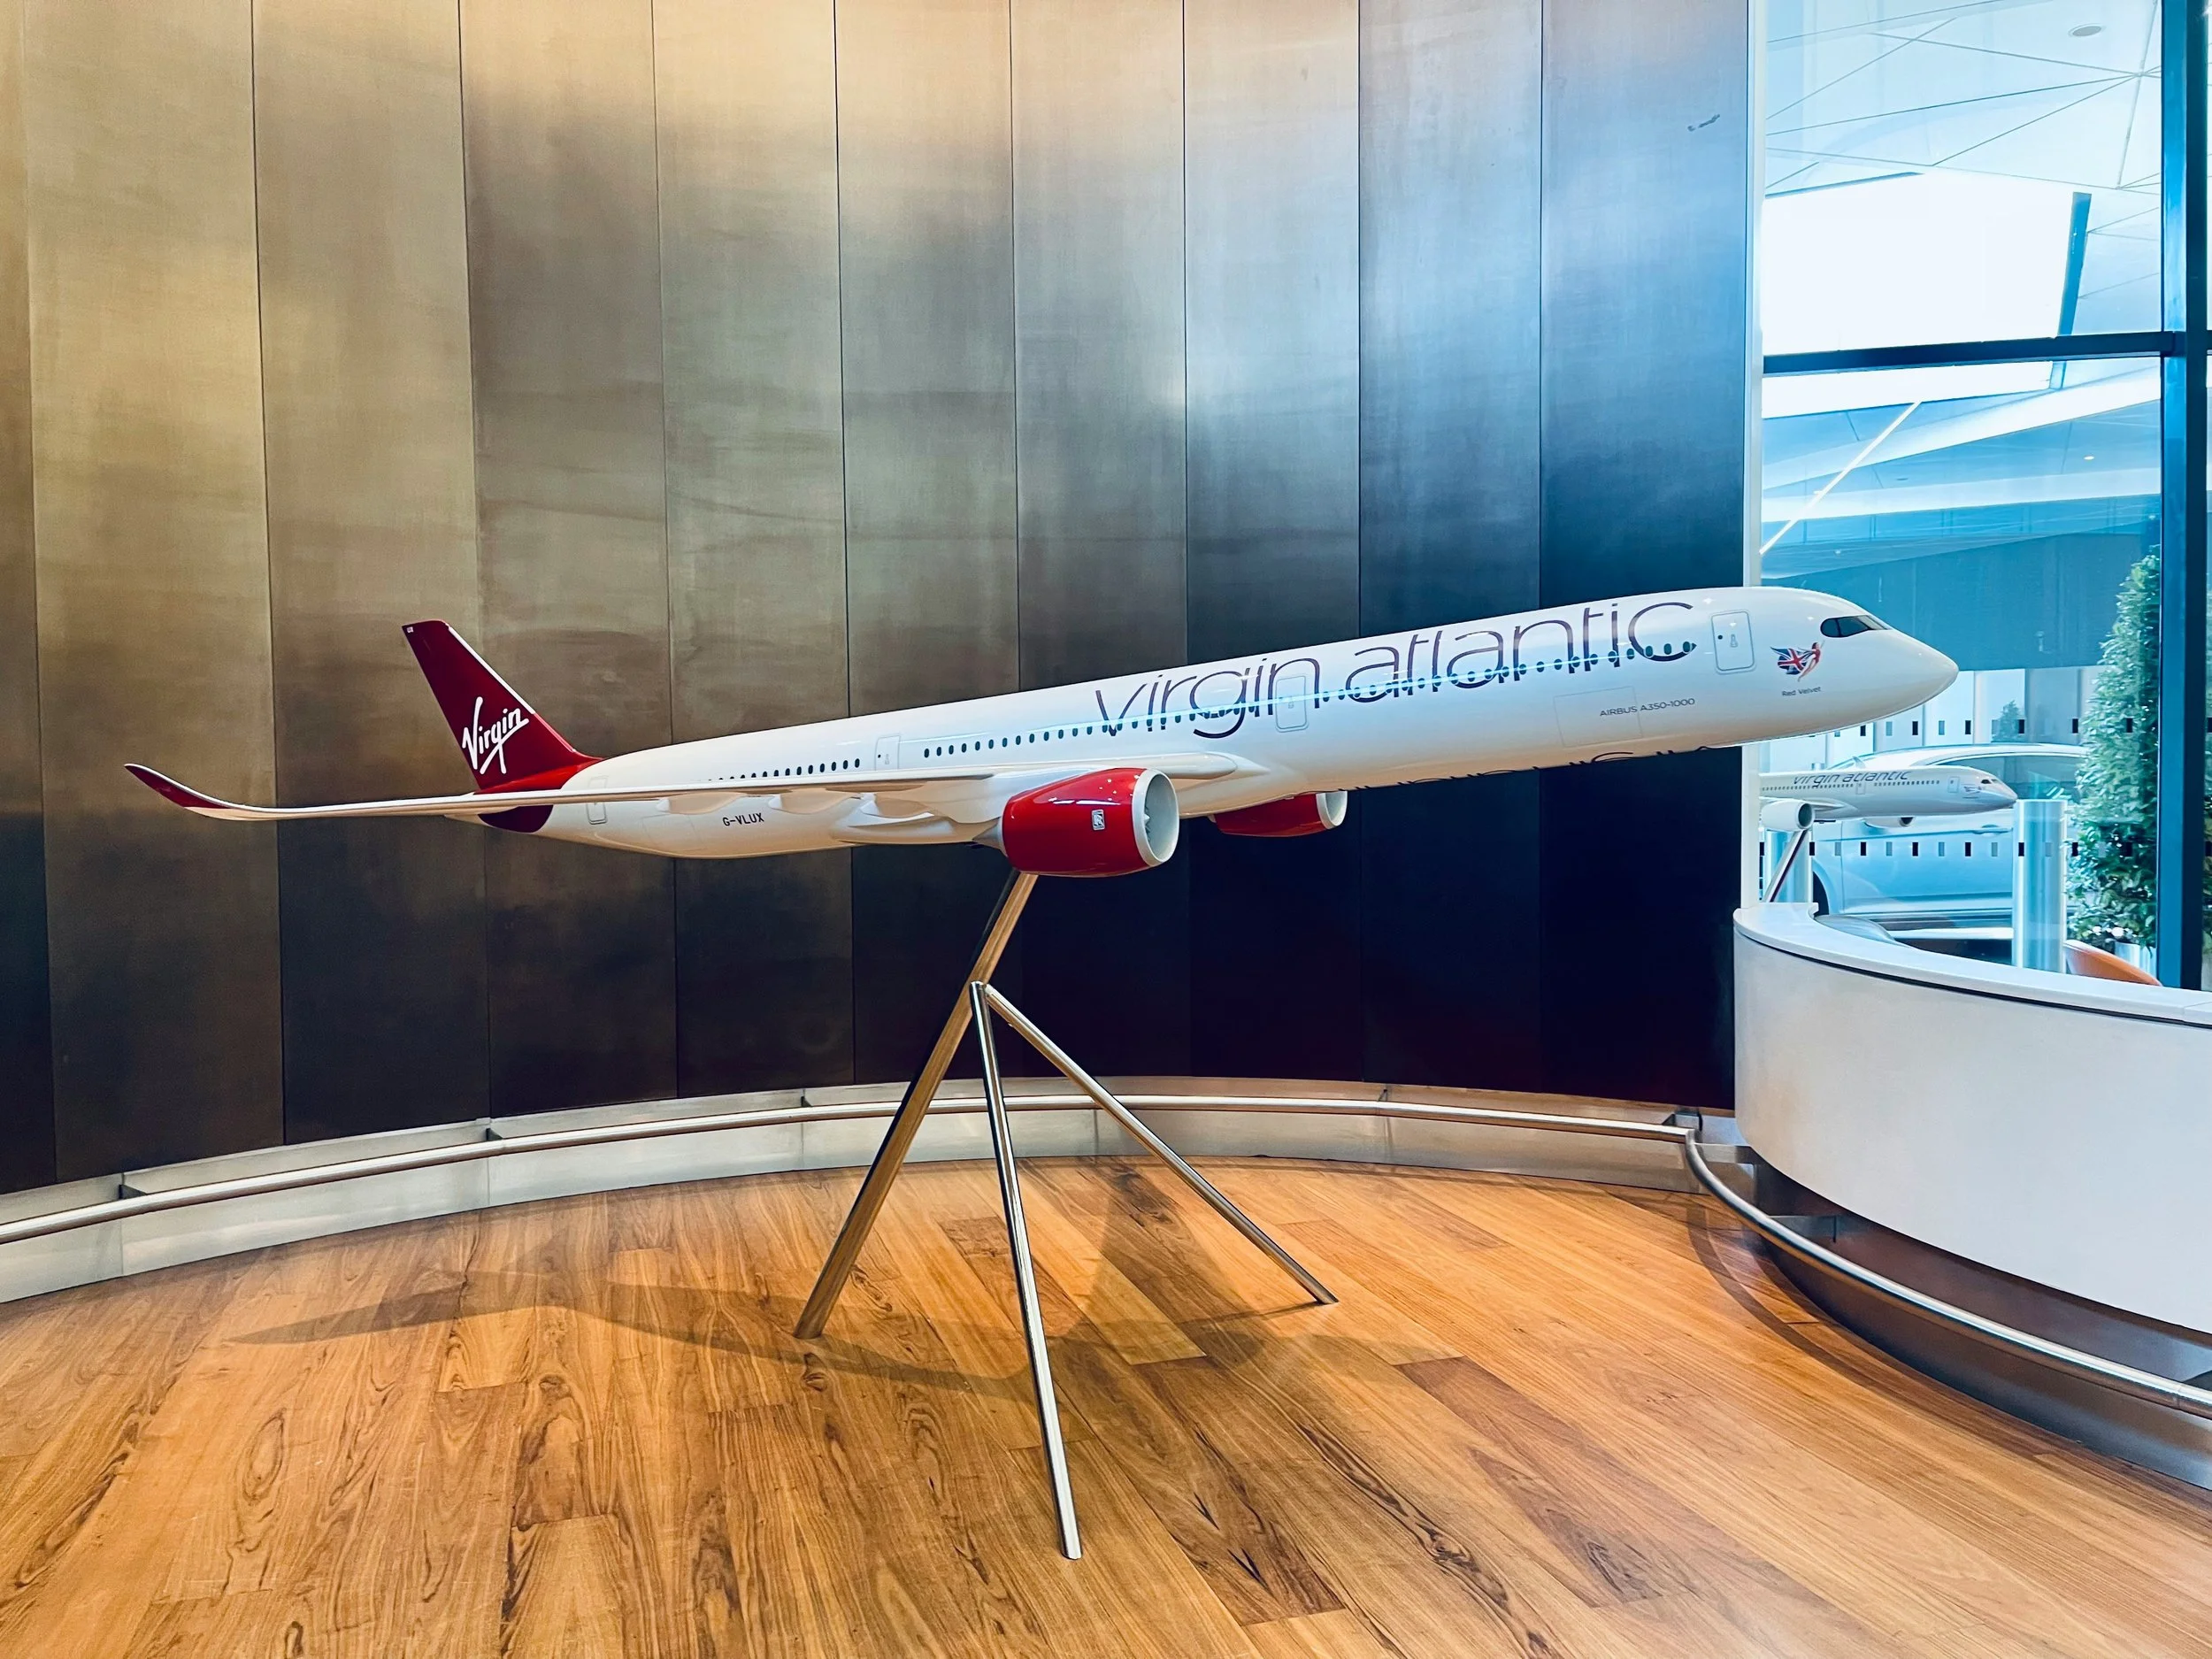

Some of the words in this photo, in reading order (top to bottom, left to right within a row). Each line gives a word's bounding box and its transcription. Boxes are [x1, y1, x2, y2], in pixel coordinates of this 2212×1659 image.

[1095, 657, 1320, 739] virgin
[1346, 603, 1697, 703] atlantic
[1600, 706, 1638, 717] AIRBUS
[1640, 698, 1695, 711] A350-1000
[462, 696, 529, 774] Virgin
[1793, 774, 1840, 787] virgin
[1842, 771, 1910, 783] atlantic
[722, 812, 764, 826] G-VLUX
